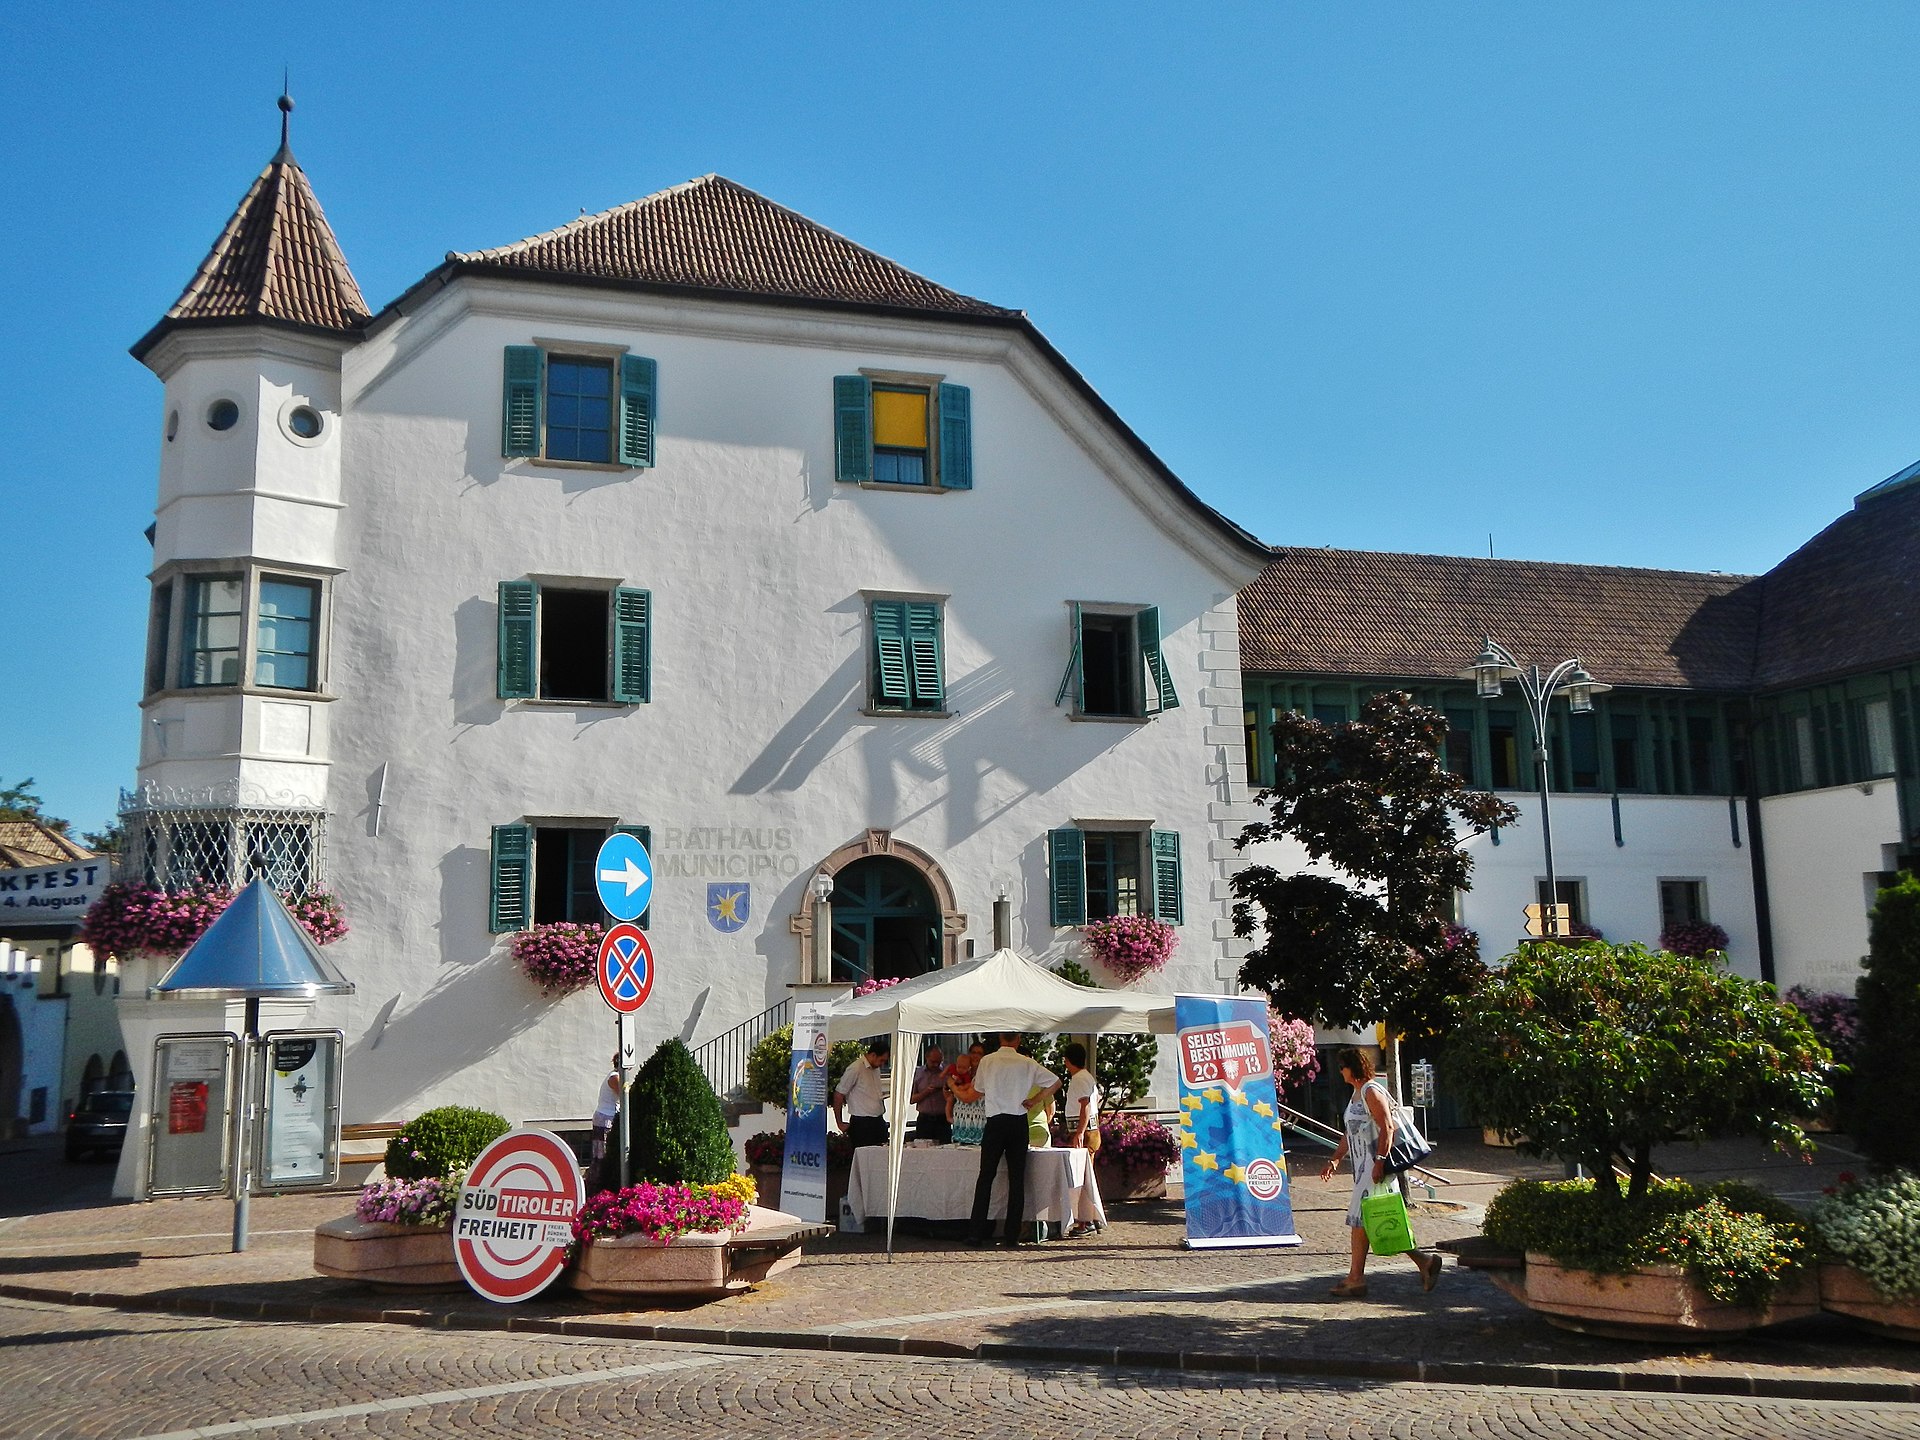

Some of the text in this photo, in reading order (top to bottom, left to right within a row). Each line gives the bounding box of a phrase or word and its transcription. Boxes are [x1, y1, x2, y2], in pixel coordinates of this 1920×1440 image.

[665, 827, 792, 850] RATHAUS
[656, 854, 800, 877] MUNICIPIO
[26, 894, 87, 909] August
[1187, 1031, 1231, 1049] SELBST-
[1189, 1042, 1257, 1063] BESTIMMUNG
[501, 1195, 575, 1217] TIROLER
[458, 1219, 538, 1240] FREIHEIT
